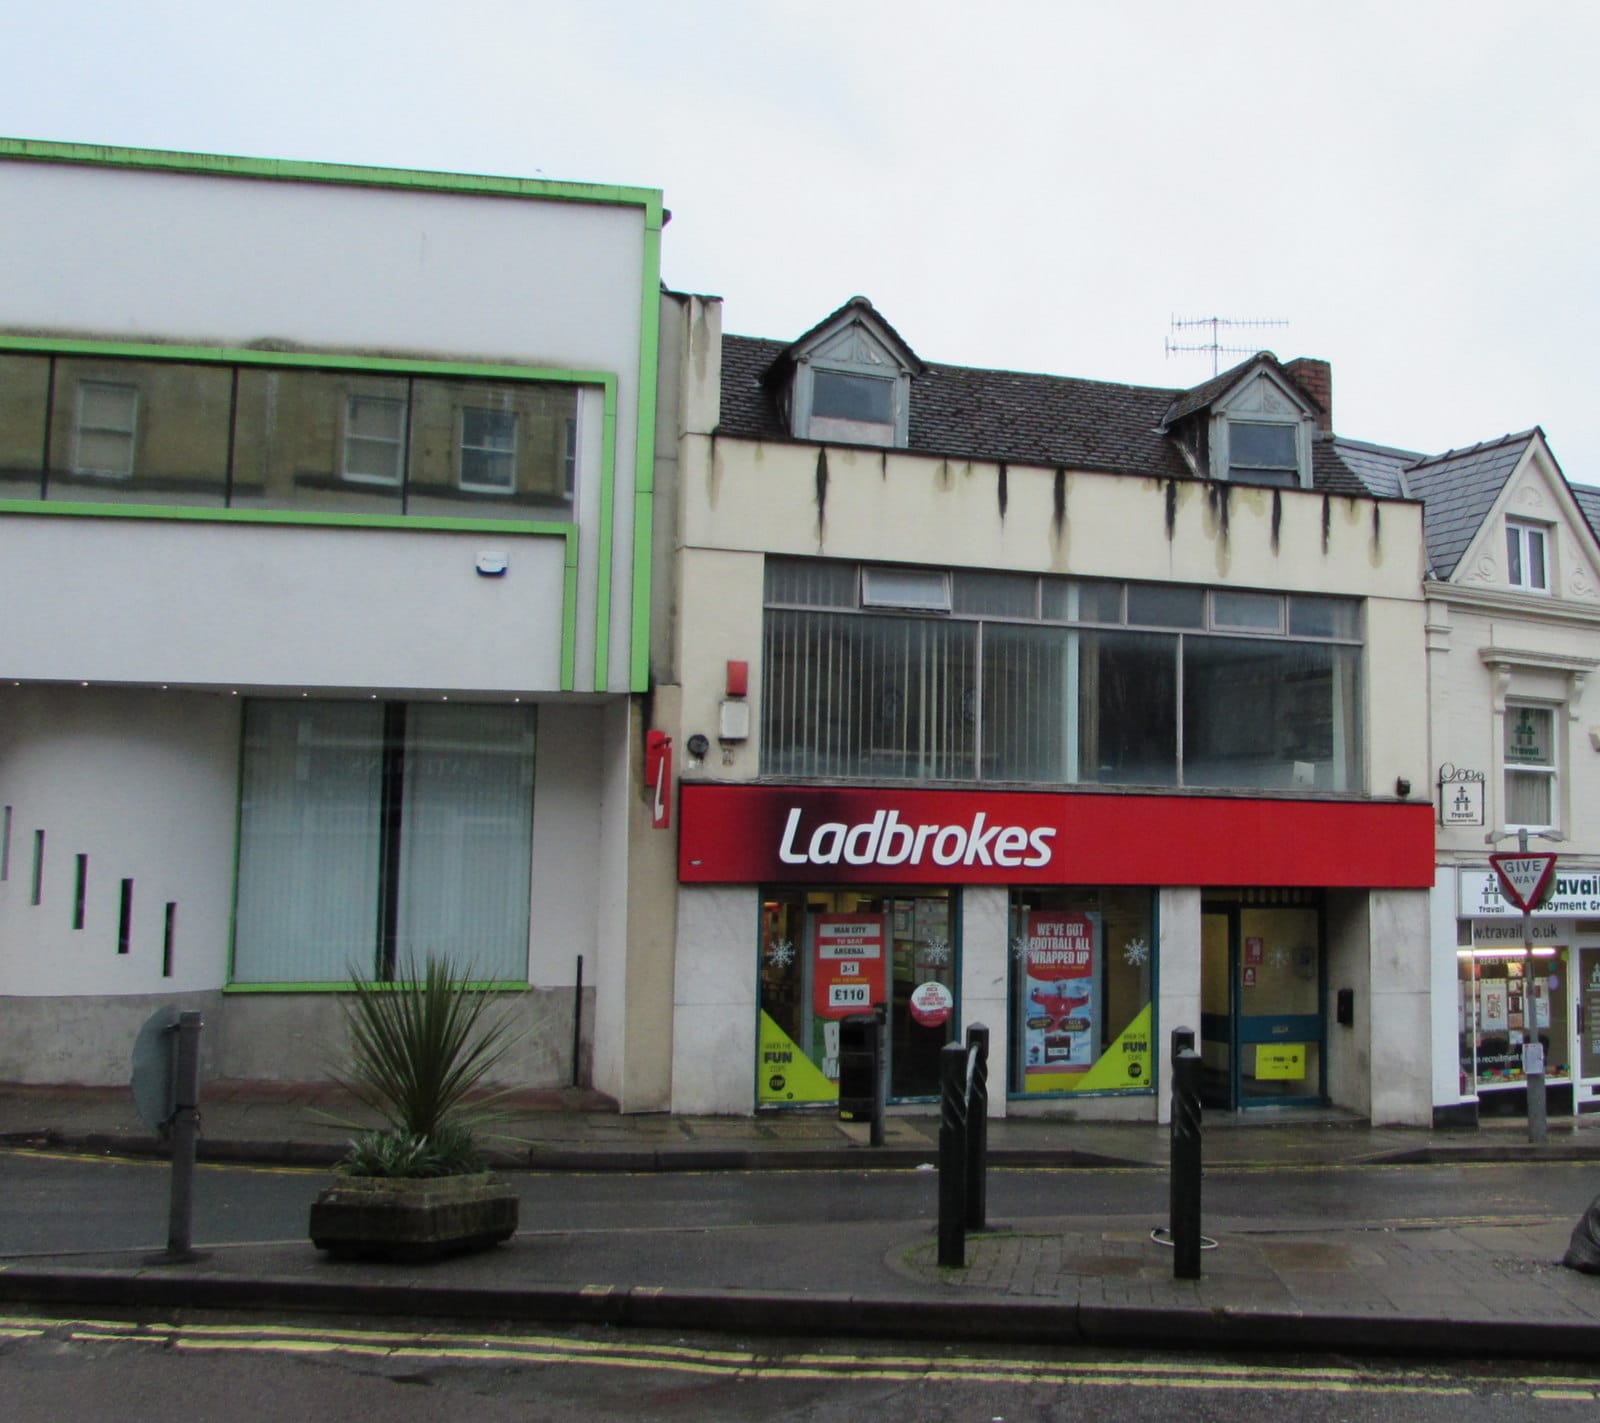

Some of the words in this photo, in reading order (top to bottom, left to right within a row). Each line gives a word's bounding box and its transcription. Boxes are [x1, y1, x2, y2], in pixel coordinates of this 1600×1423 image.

[1511, 745, 1539, 756] Travail
[778, 807, 1057, 867] Ladbrokes
[1504, 860, 1542, 873] GIVE
[1512, 875, 1537, 884] WAY
[1479, 905, 1505, 913] Travail
[1037, 923, 1065, 936] WE'VE
[1066, 923, 1084, 936] GOT
[1030, 937, 1073, 950] FOOTBALL
[1075, 937, 1090, 950] ALL
[1031, 951, 1075, 964] WRAPPED
[1077, 951, 1089, 964] UP
[842, 964, 855, 973] 3-1
[834, 989, 865, 1001] £110
[1122, 1041, 1148, 1053] FUN
[764, 1051, 793, 1064] FUN
[1482, 1053, 1520, 1064] recruitment
